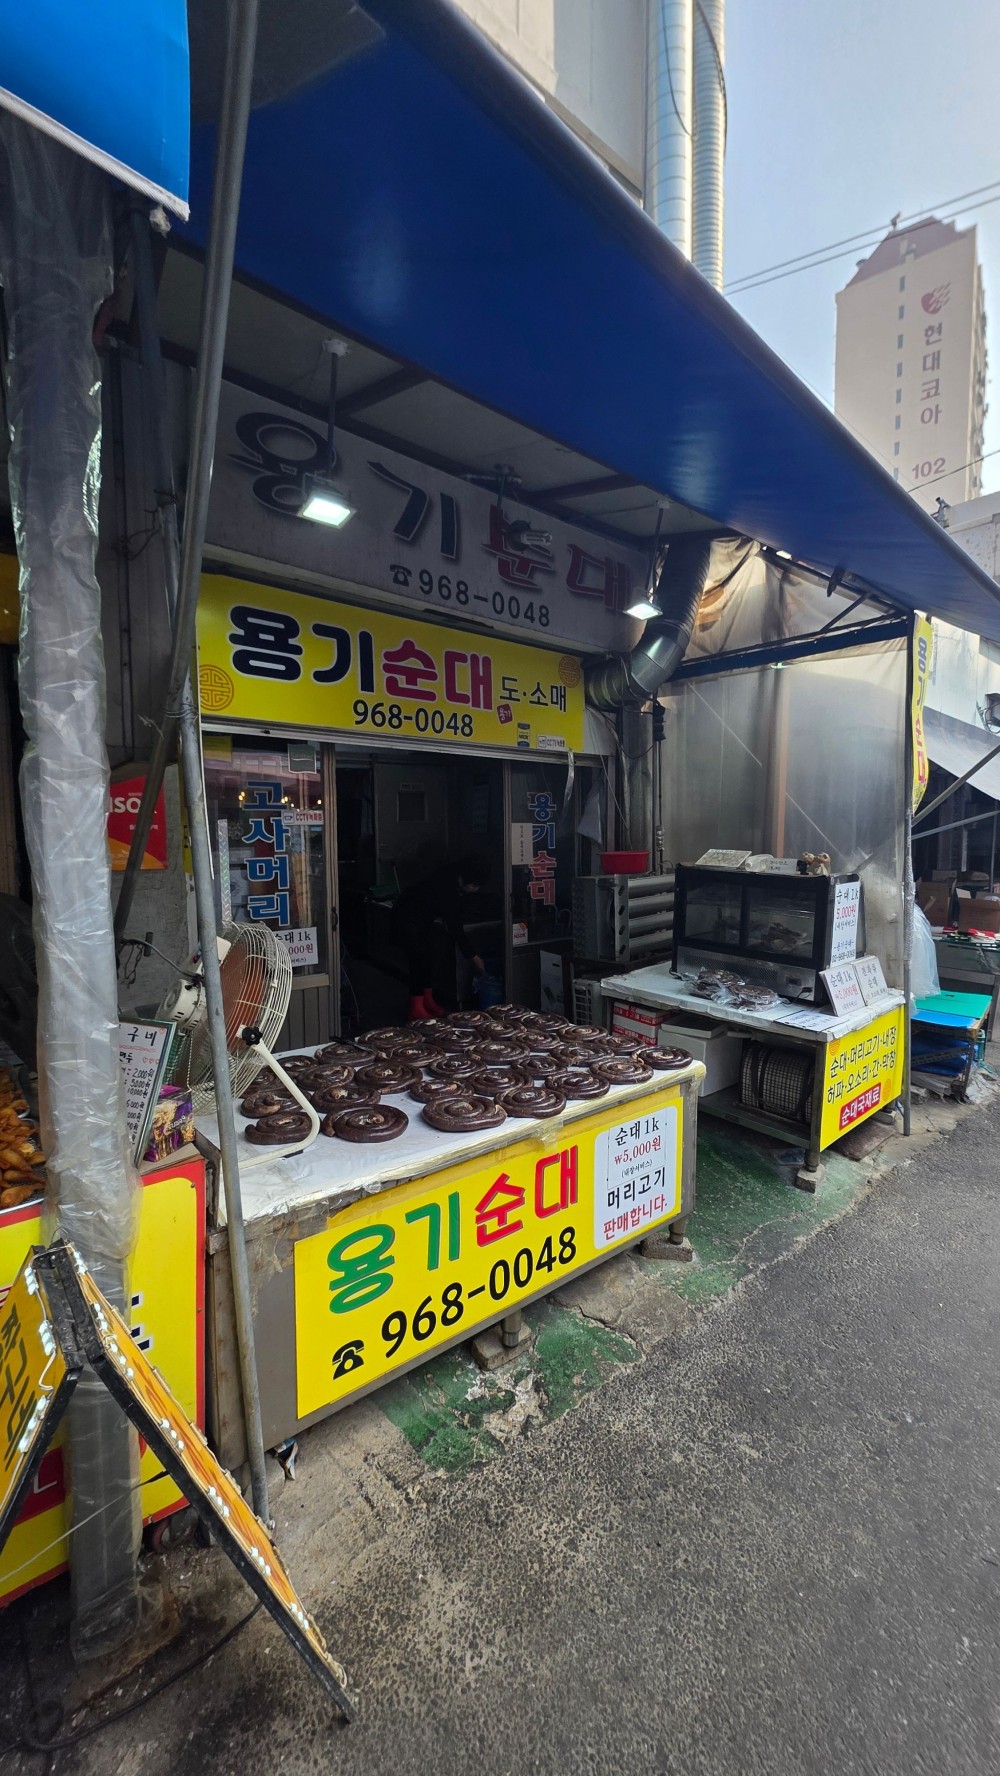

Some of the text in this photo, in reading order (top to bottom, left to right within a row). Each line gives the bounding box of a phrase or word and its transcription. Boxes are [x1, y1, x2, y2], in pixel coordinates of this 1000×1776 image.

[919, 322, 943, 424] 현대코아
[911, 457, 946, 480] 102
[227, 412, 631, 613] 용기순대
[419, 569, 550, 627] 968-0048
[228, 605, 494, 711] 용기순대
[353, 699, 474, 739] 968-0048
[109, 796, 142, 814] SO
[241, 780, 291, 927] 고사머리
[528, 792, 558, 905] 용기순대
[836, 888, 849, 905] 순대
[288, 943, 314, 955] 000원
[298, 931, 312, 942] 1k
[830, 1025, 897, 1079] 순대·머리고기·내장
[841, 1085, 880, 1127] 순대국재료
[614, 1117, 660, 1147] 순대 1k
[607, 1166, 666, 1209] 머리고기
[621, 1159, 653, 1178] (내장서비스)
[327, 1144, 579, 1314] 용기순대
[603, 1193, 668, 1241] 판매합니다.
[382, 1226, 577, 1359] 968-0048
